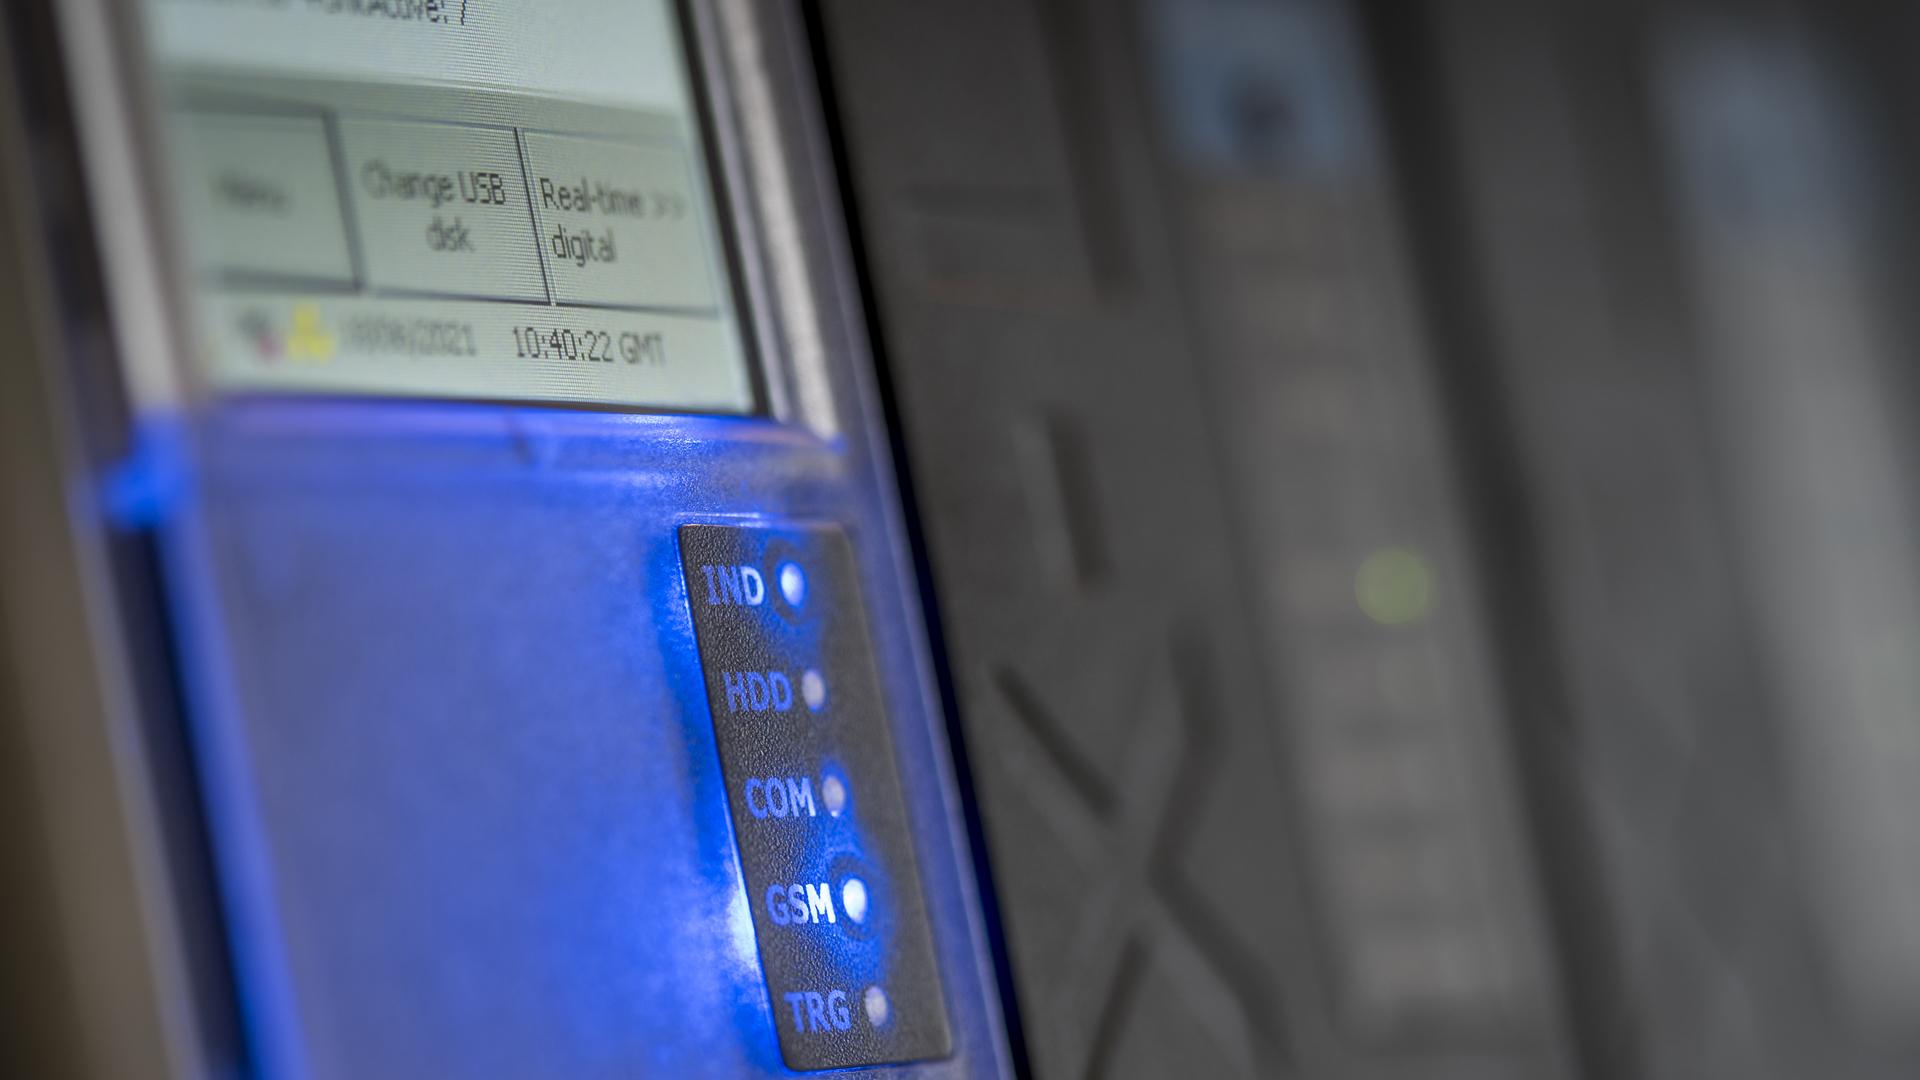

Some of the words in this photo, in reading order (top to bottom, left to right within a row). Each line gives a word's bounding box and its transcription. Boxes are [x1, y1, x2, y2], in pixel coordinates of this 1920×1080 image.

[362, 160, 454, 207] Change
[458, 171, 506, 205] USB
[540, 177, 645, 217] Real-time
[426, 217, 474, 251] disk
[551, 224, 617, 267] digital
[513, 326, 613, 362] 10:40:22
[619, 331, 666, 366] GMT
[703, 565, 765, 606] IND
[724, 671, 794, 712] HDD
[744, 777, 817, 819] COM
[765, 883, 837, 926] GSM
[785, 990, 852, 1033] TRG
